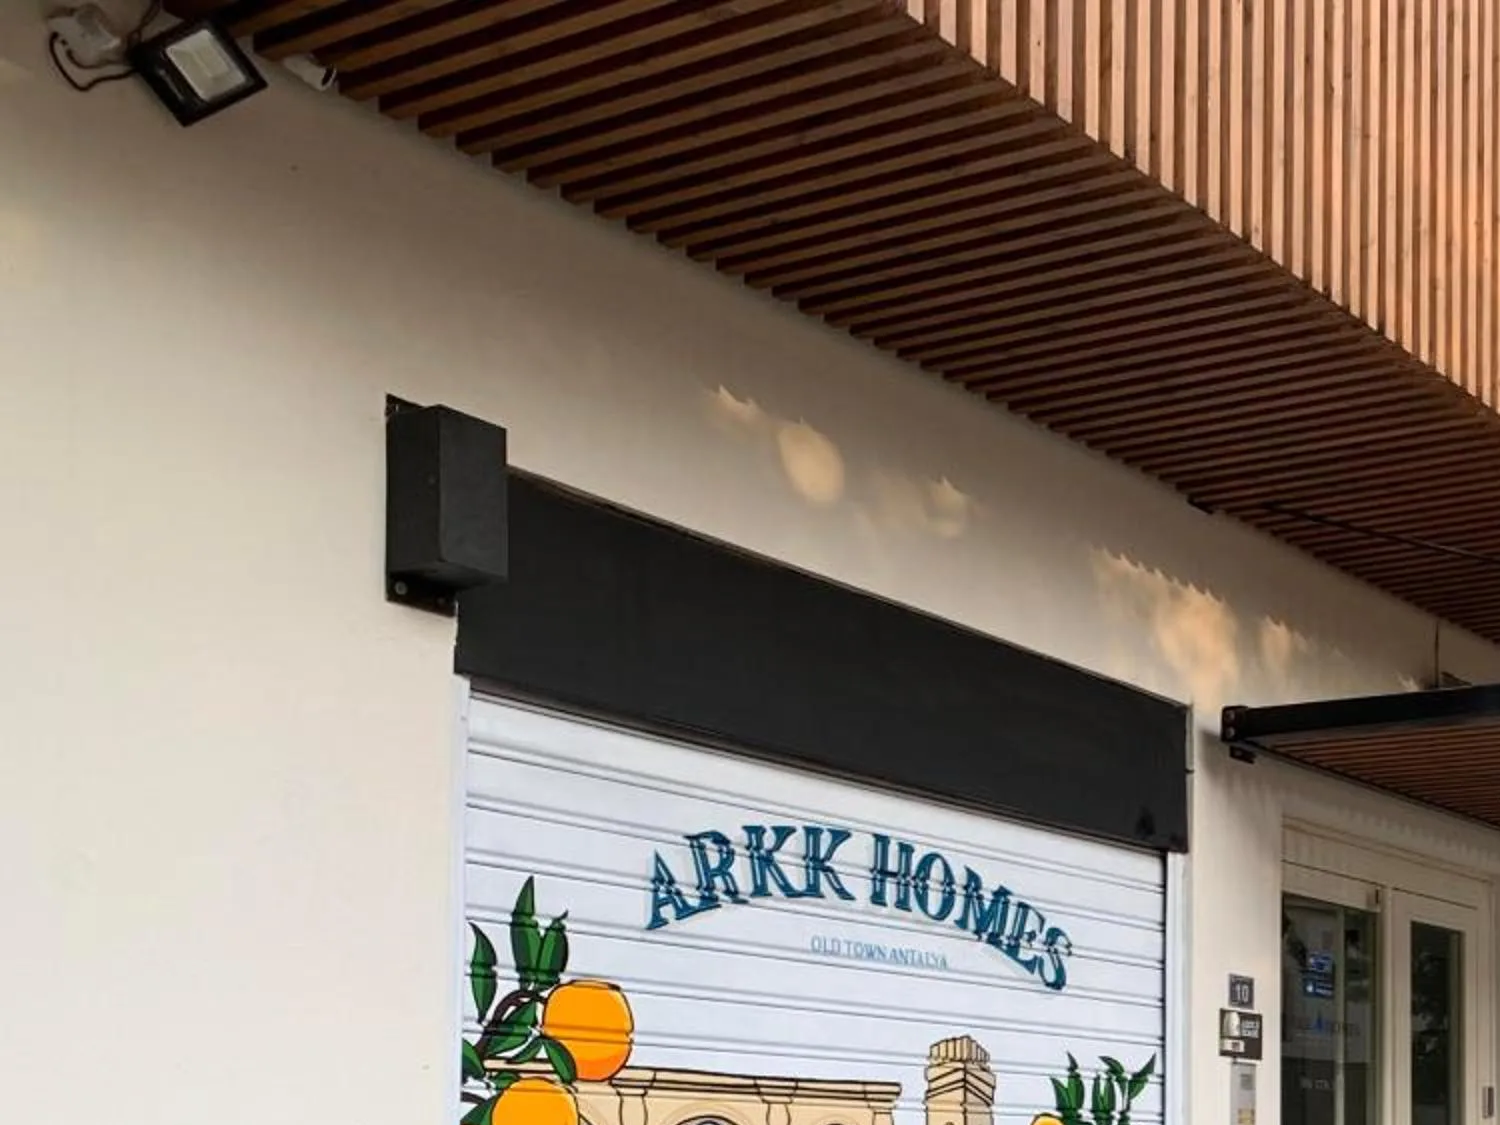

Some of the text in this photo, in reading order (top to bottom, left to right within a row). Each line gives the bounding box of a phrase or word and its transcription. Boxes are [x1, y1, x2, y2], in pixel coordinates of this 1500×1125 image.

[643, 824, 1074, 991] ARKK HOMES
[810, 934, 949, 971] OLD TOWN ANTALYA
